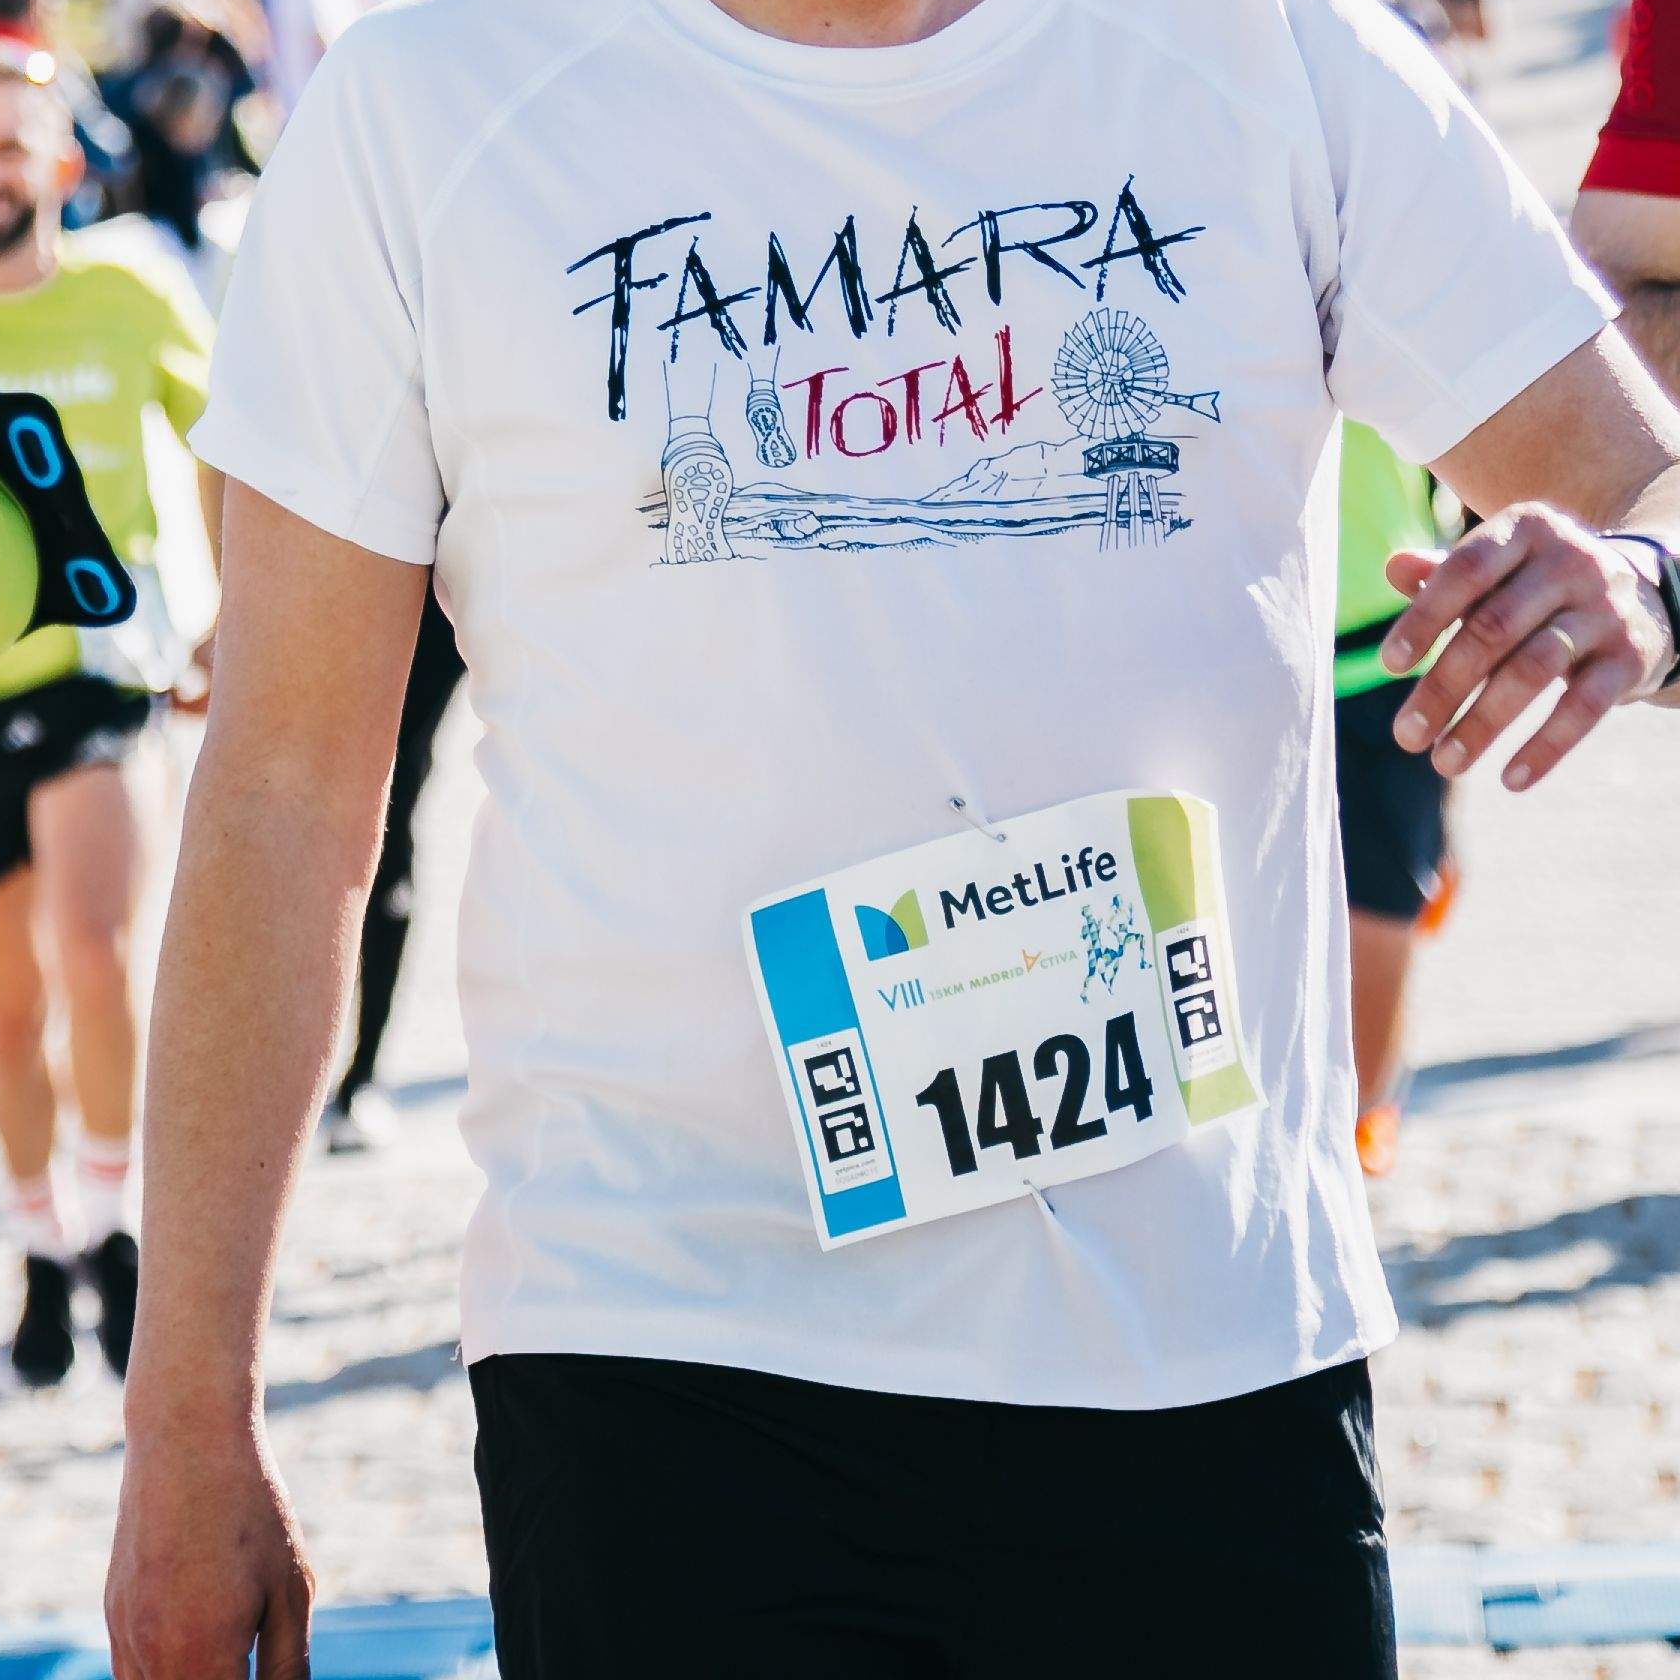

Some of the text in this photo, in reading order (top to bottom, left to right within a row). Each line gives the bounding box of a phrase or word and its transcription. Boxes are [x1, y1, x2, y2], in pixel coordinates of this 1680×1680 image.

[566, 173, 1206, 422] FAMARA
[781, 324, 1042, 459] TOTAL
[939, 846, 1118, 930] MetLife
[877, 978, 925, 1013] VIII
[929, 984, 965, 1001] 15KM
[969, 966, 1024, 991] MADRID
[916, 1010, 1154, 1178] 1424
